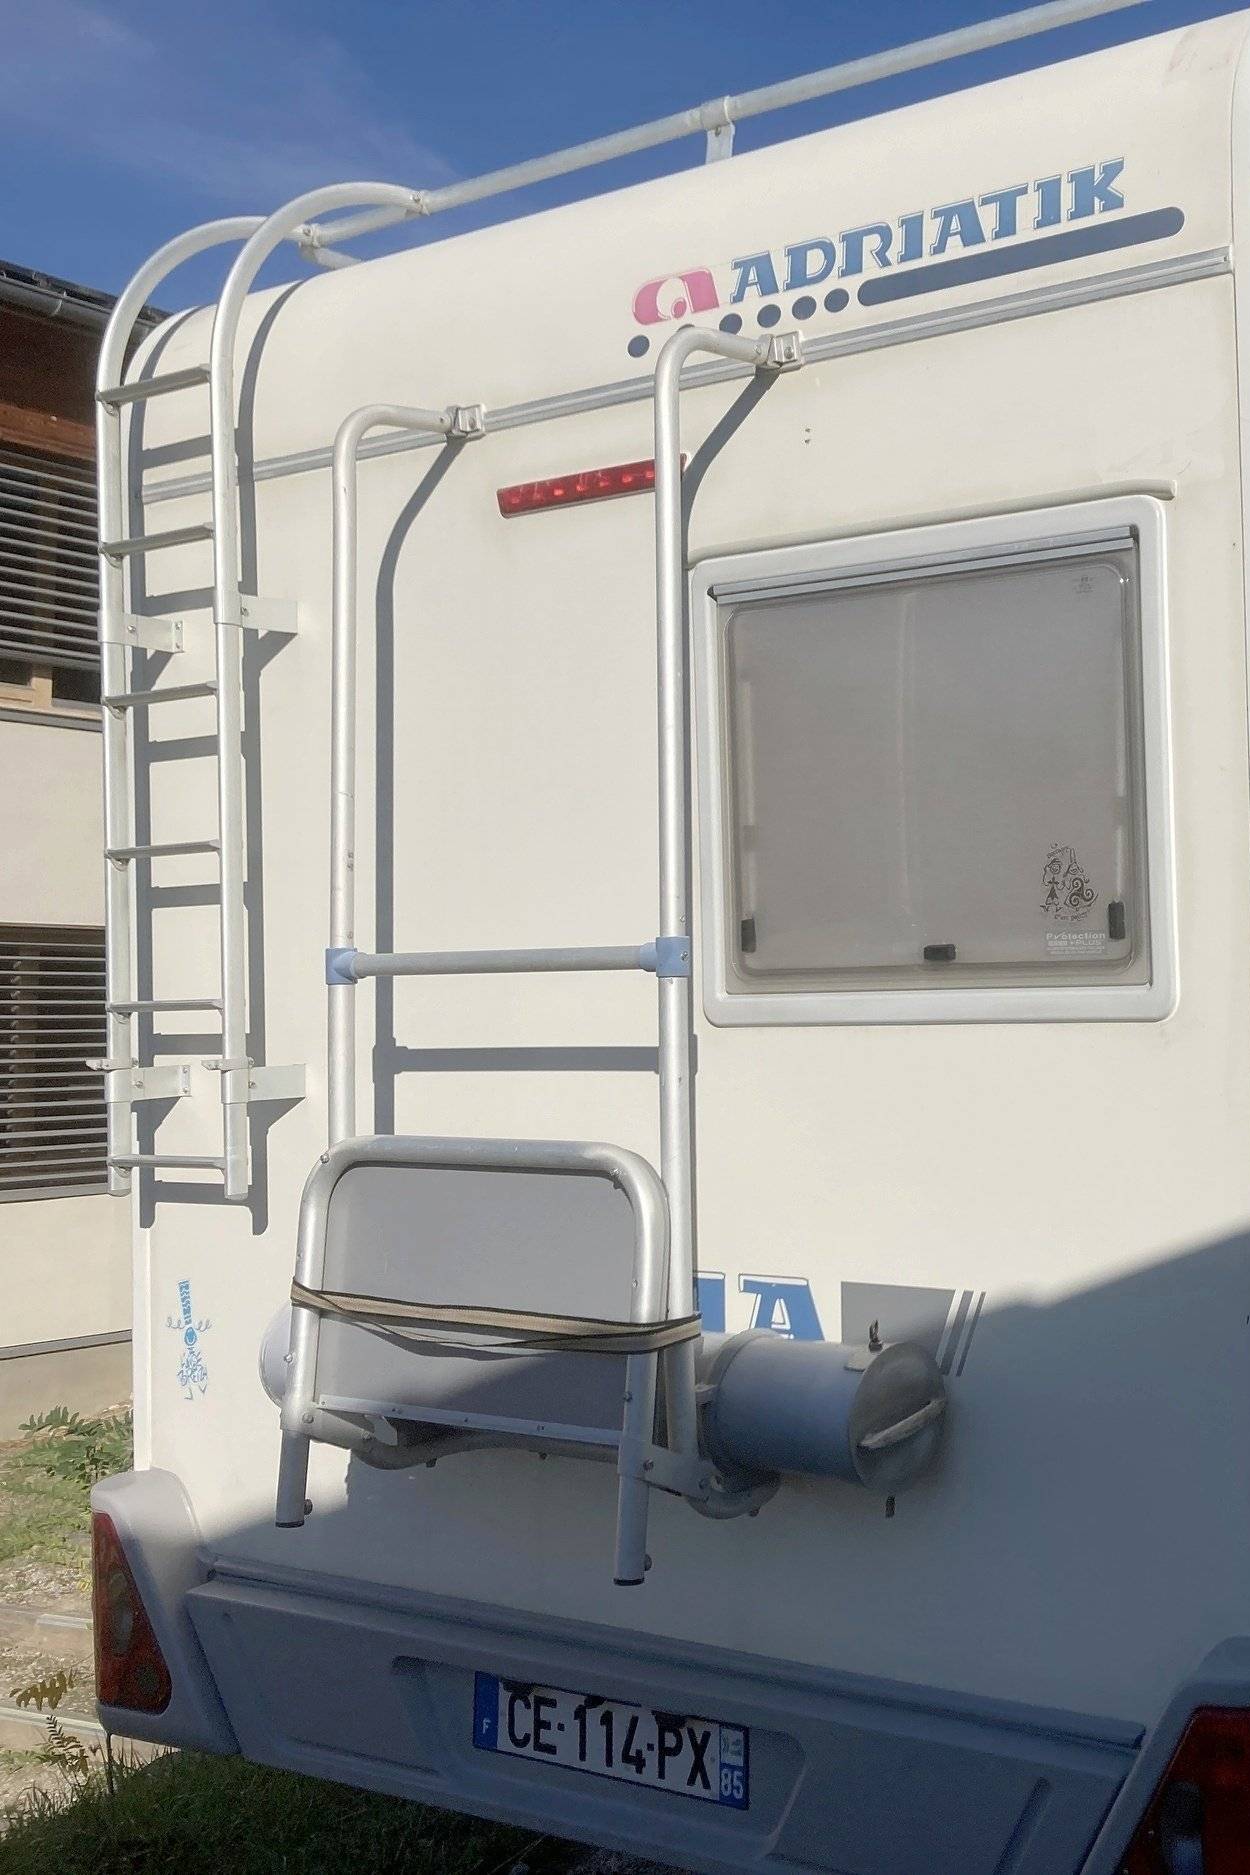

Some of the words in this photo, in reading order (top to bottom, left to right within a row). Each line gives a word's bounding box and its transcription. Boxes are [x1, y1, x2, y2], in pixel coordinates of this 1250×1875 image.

[730, 157, 1126, 304] ADRIATIK
[482, 1717, 491, 1735] F
[720, 1767, 744, 1800] 85
